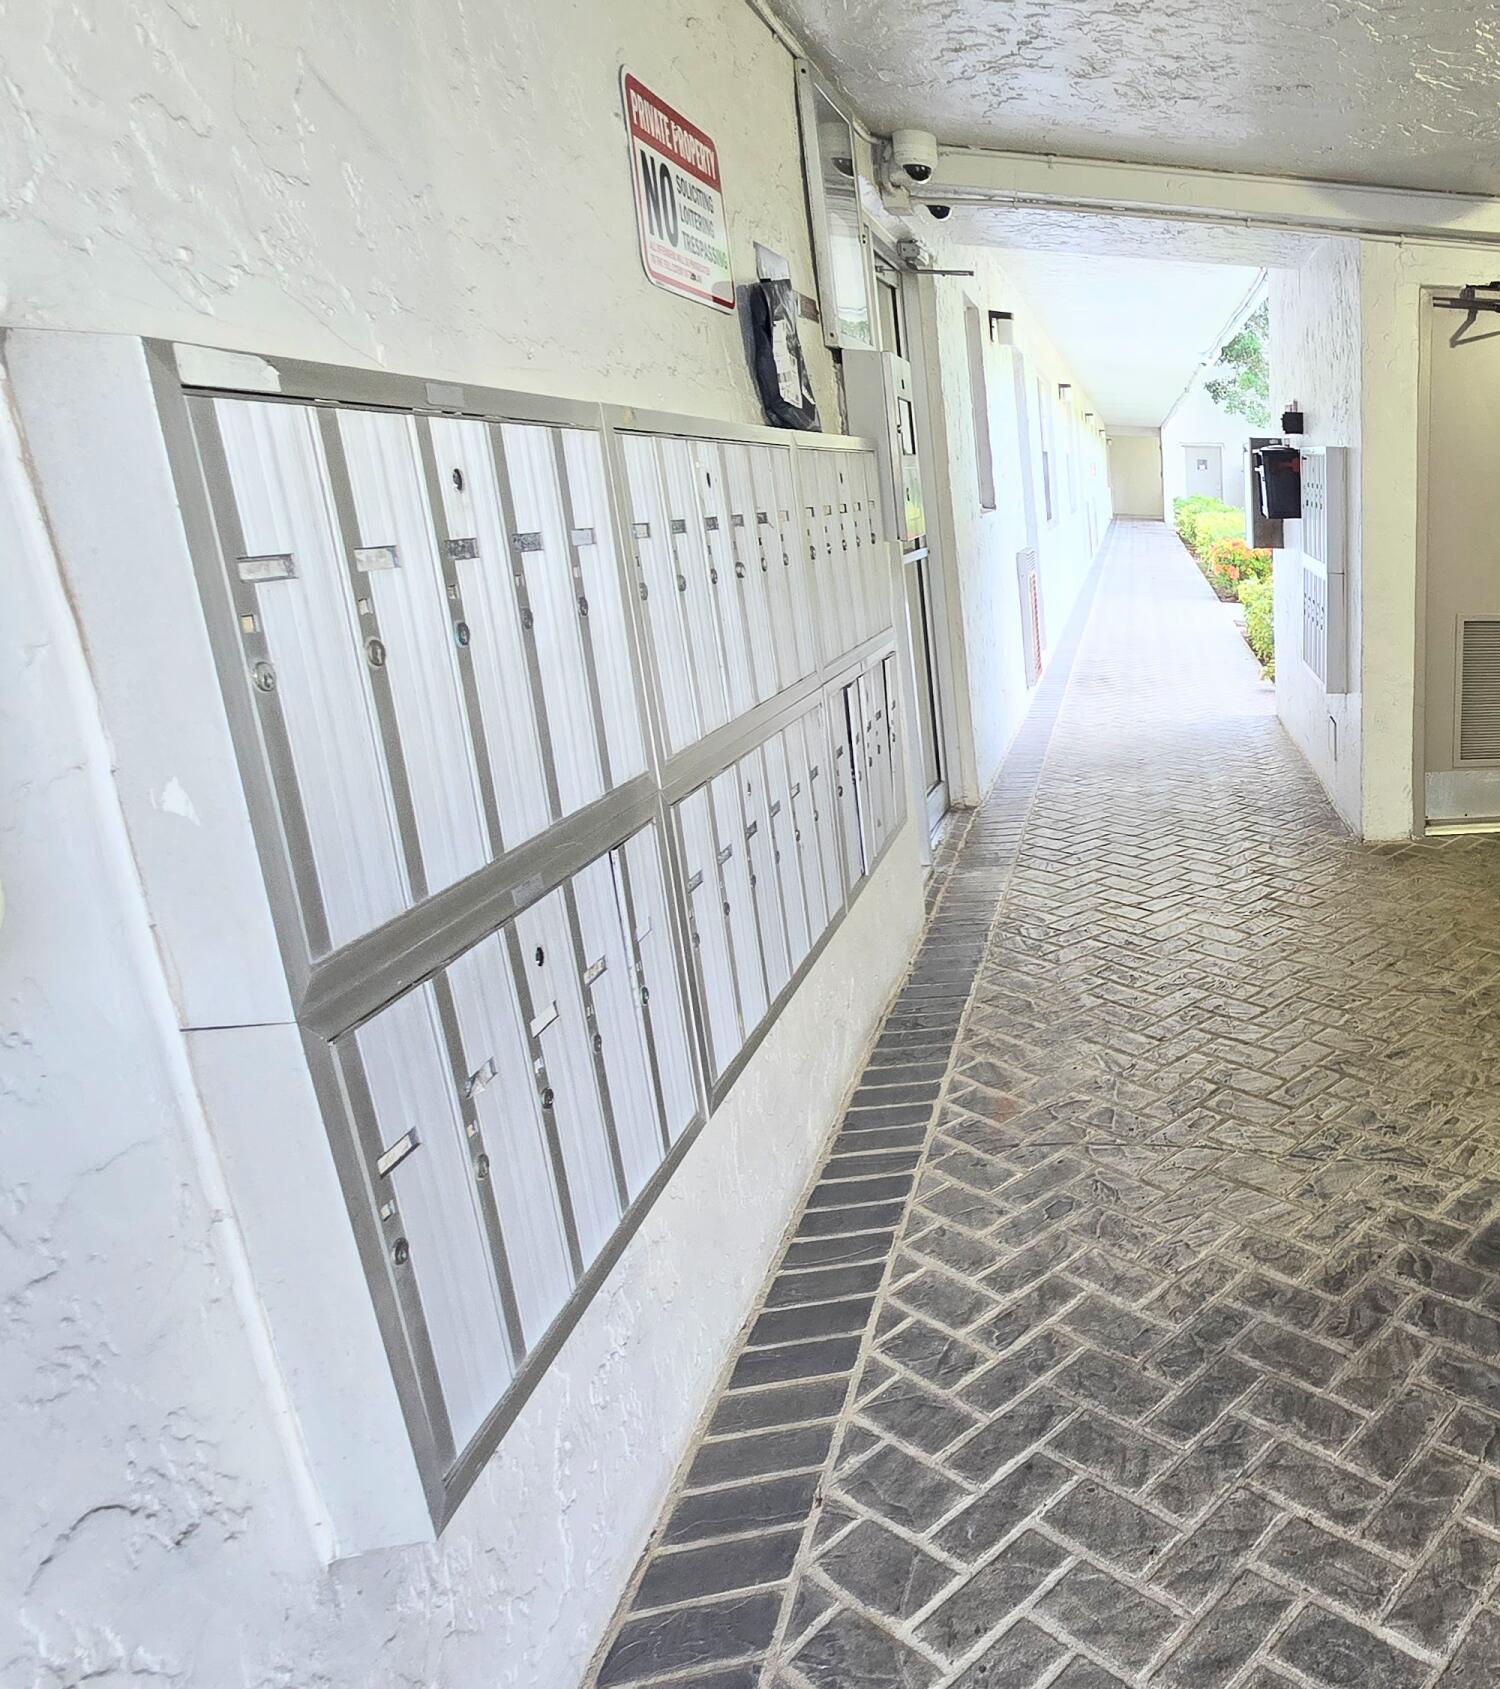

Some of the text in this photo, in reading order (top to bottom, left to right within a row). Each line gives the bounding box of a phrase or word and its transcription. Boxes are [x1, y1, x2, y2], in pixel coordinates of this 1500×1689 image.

[630, 89, 717, 180] PRIVATE PROPERTY
[640, 149, 678, 247] NO
[676, 174, 714, 213] SOLICITING
[678, 203, 715, 239] LOITERING
[681, 231, 728, 269] TRESPASSING
